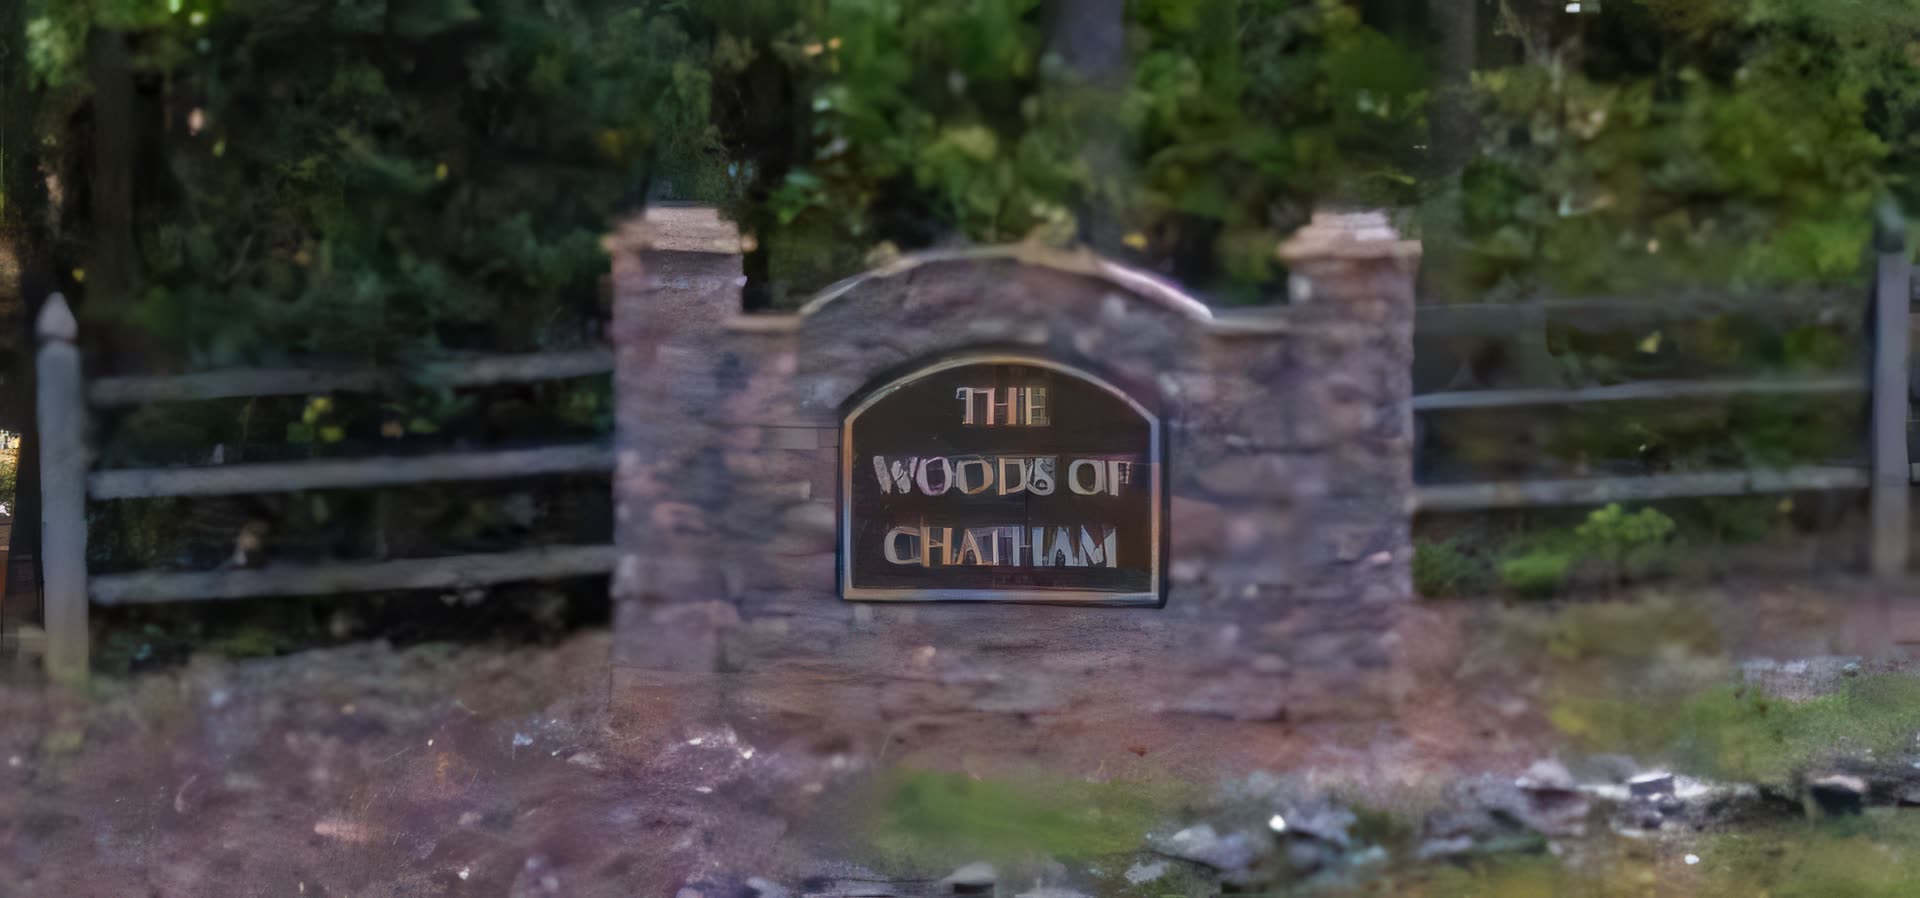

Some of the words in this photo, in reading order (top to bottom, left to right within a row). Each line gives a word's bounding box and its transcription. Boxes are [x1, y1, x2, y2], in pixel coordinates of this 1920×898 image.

[956, 387, 1050, 425] THE
[873, 456, 1056, 496] WOODS
[1068, 459, 1132, 496] OF
[884, 525, 1118, 568] CHATHAM
